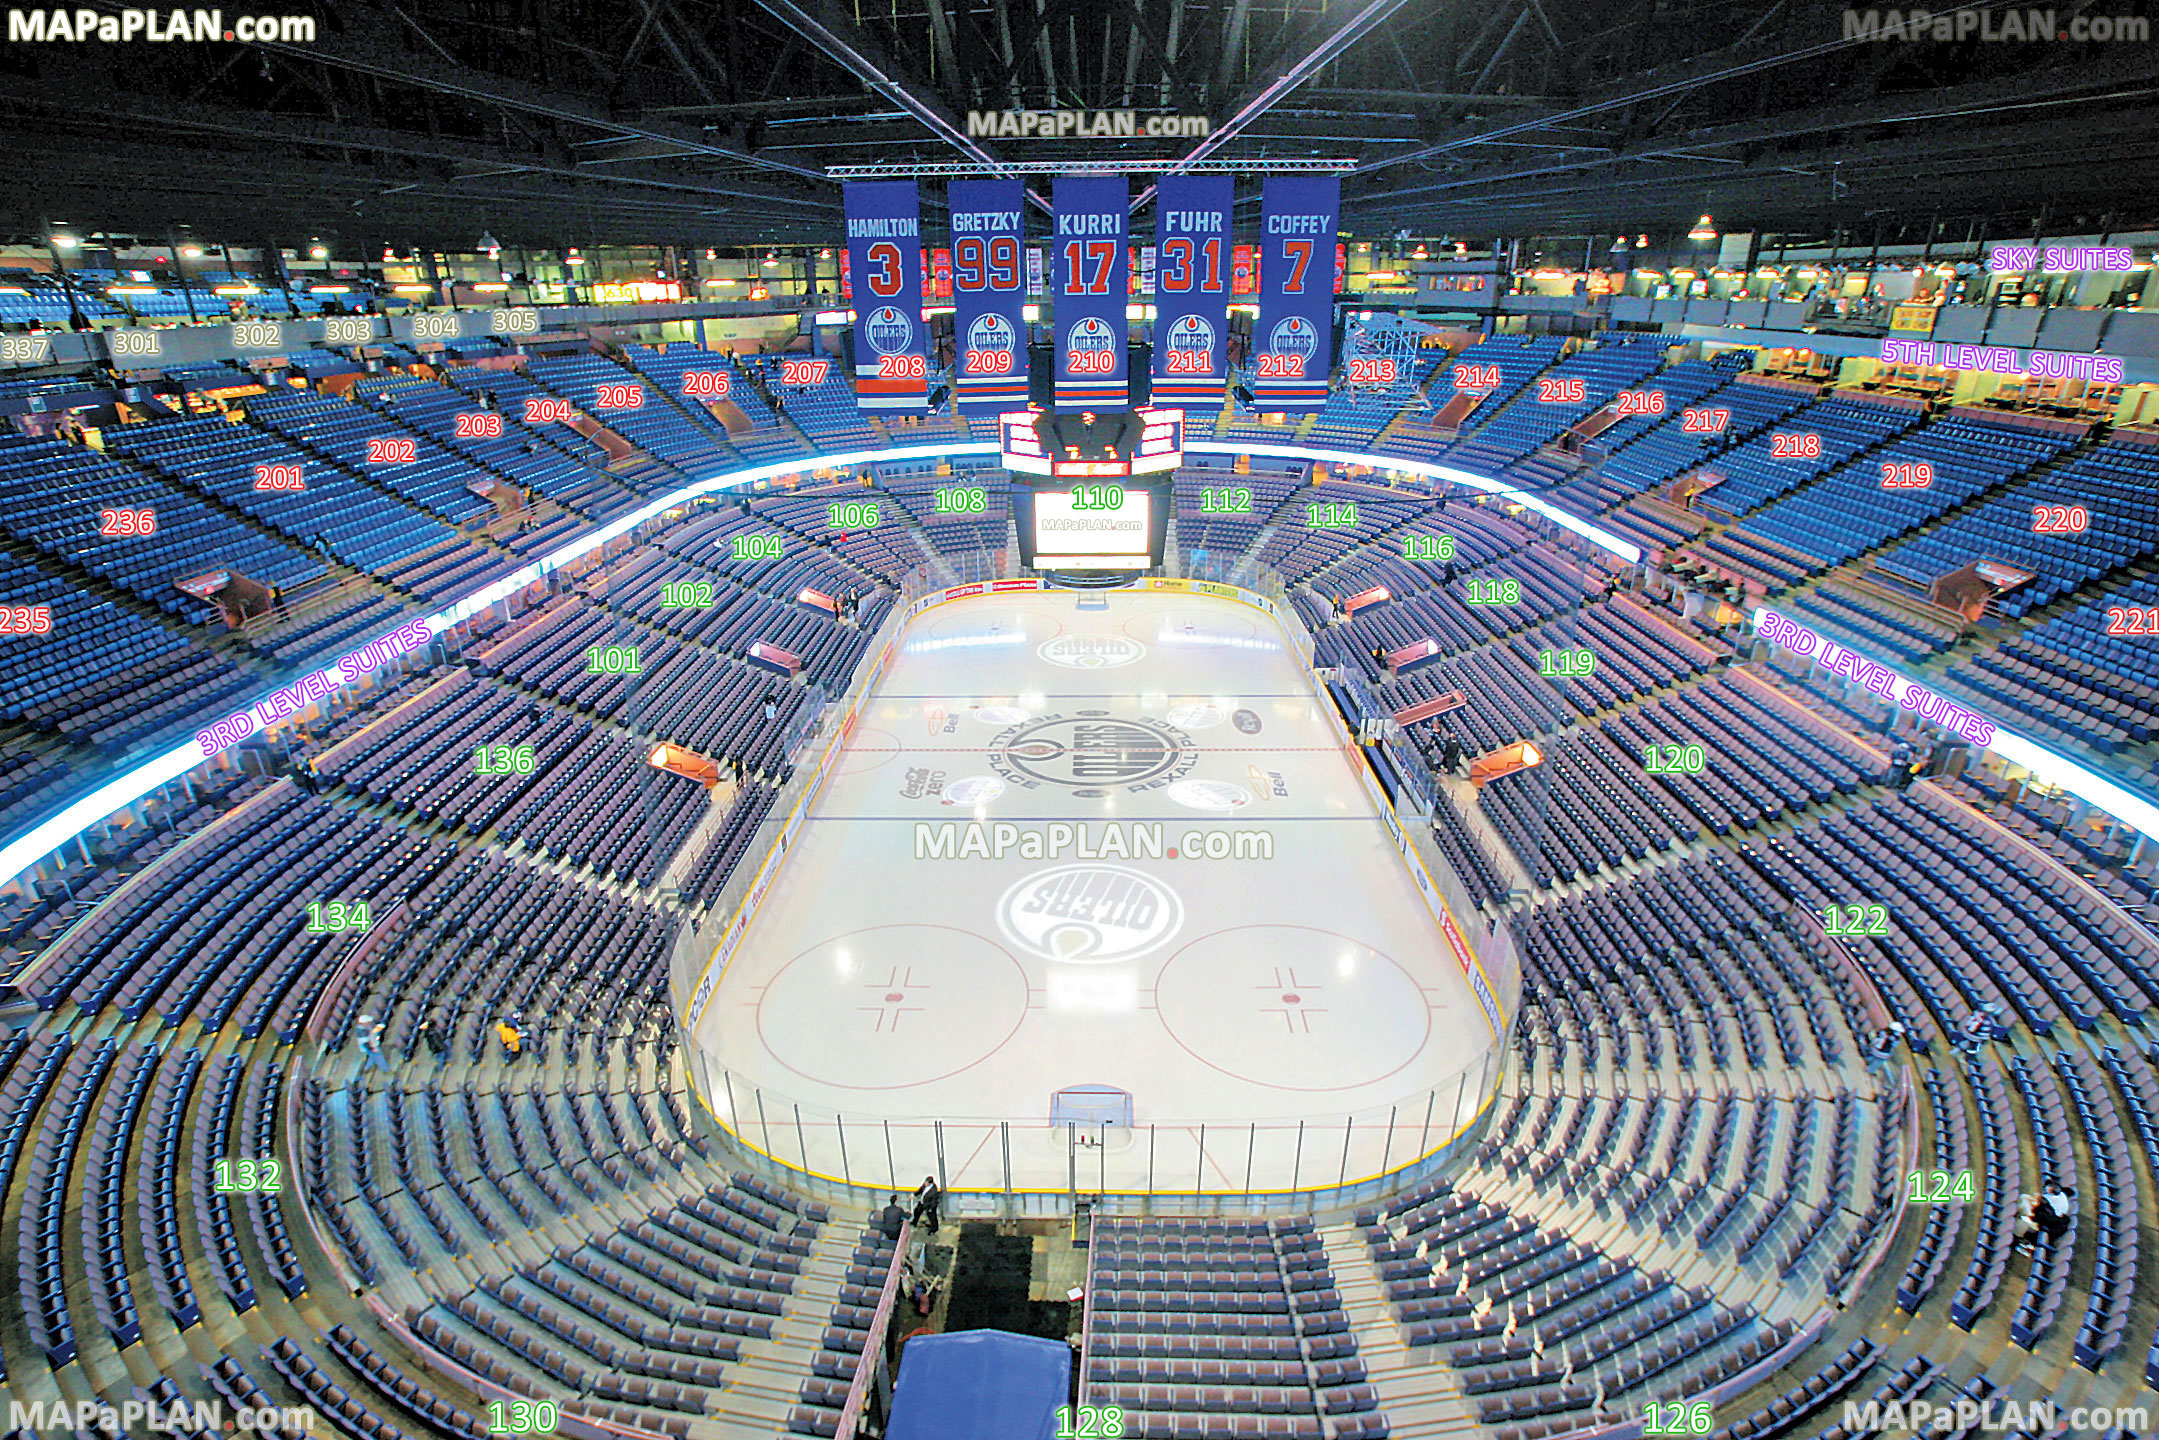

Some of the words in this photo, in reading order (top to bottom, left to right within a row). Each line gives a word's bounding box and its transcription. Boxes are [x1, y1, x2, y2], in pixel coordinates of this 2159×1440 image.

[848, 218, 918, 237] HAMILTON
[952, 211, 1020, 232] GRETZKY
[1059, 213, 1121, 235] KURRI
[1166, 211, 1223, 232] FUHR
[1268, 215, 1331, 234] COFFEY
[868, 242, 903, 297] 3
[954, 235, 1021, 292] 99
[1063, 240, 1117, 296] 17
[1161, 236, 1223, 293] 31
[1282, 239, 1314, 295] 7
[872, 324, 906, 340] OILERS
[975, 331, 1009, 346] OILERS
[1075, 334, 1110, 350] OILERS
[1174, 333, 1209, 349] OILERS
[1276, 334, 1312, 349] OILERS
[987, 753, 1041, 790] PLACE
[1127, 753, 1199, 793] REXALL
[1267, 771, 1289, 797] Bell
[1021, 878, 1159, 932] OILERS
[1473, 974, 1504, 1040] SAMS
